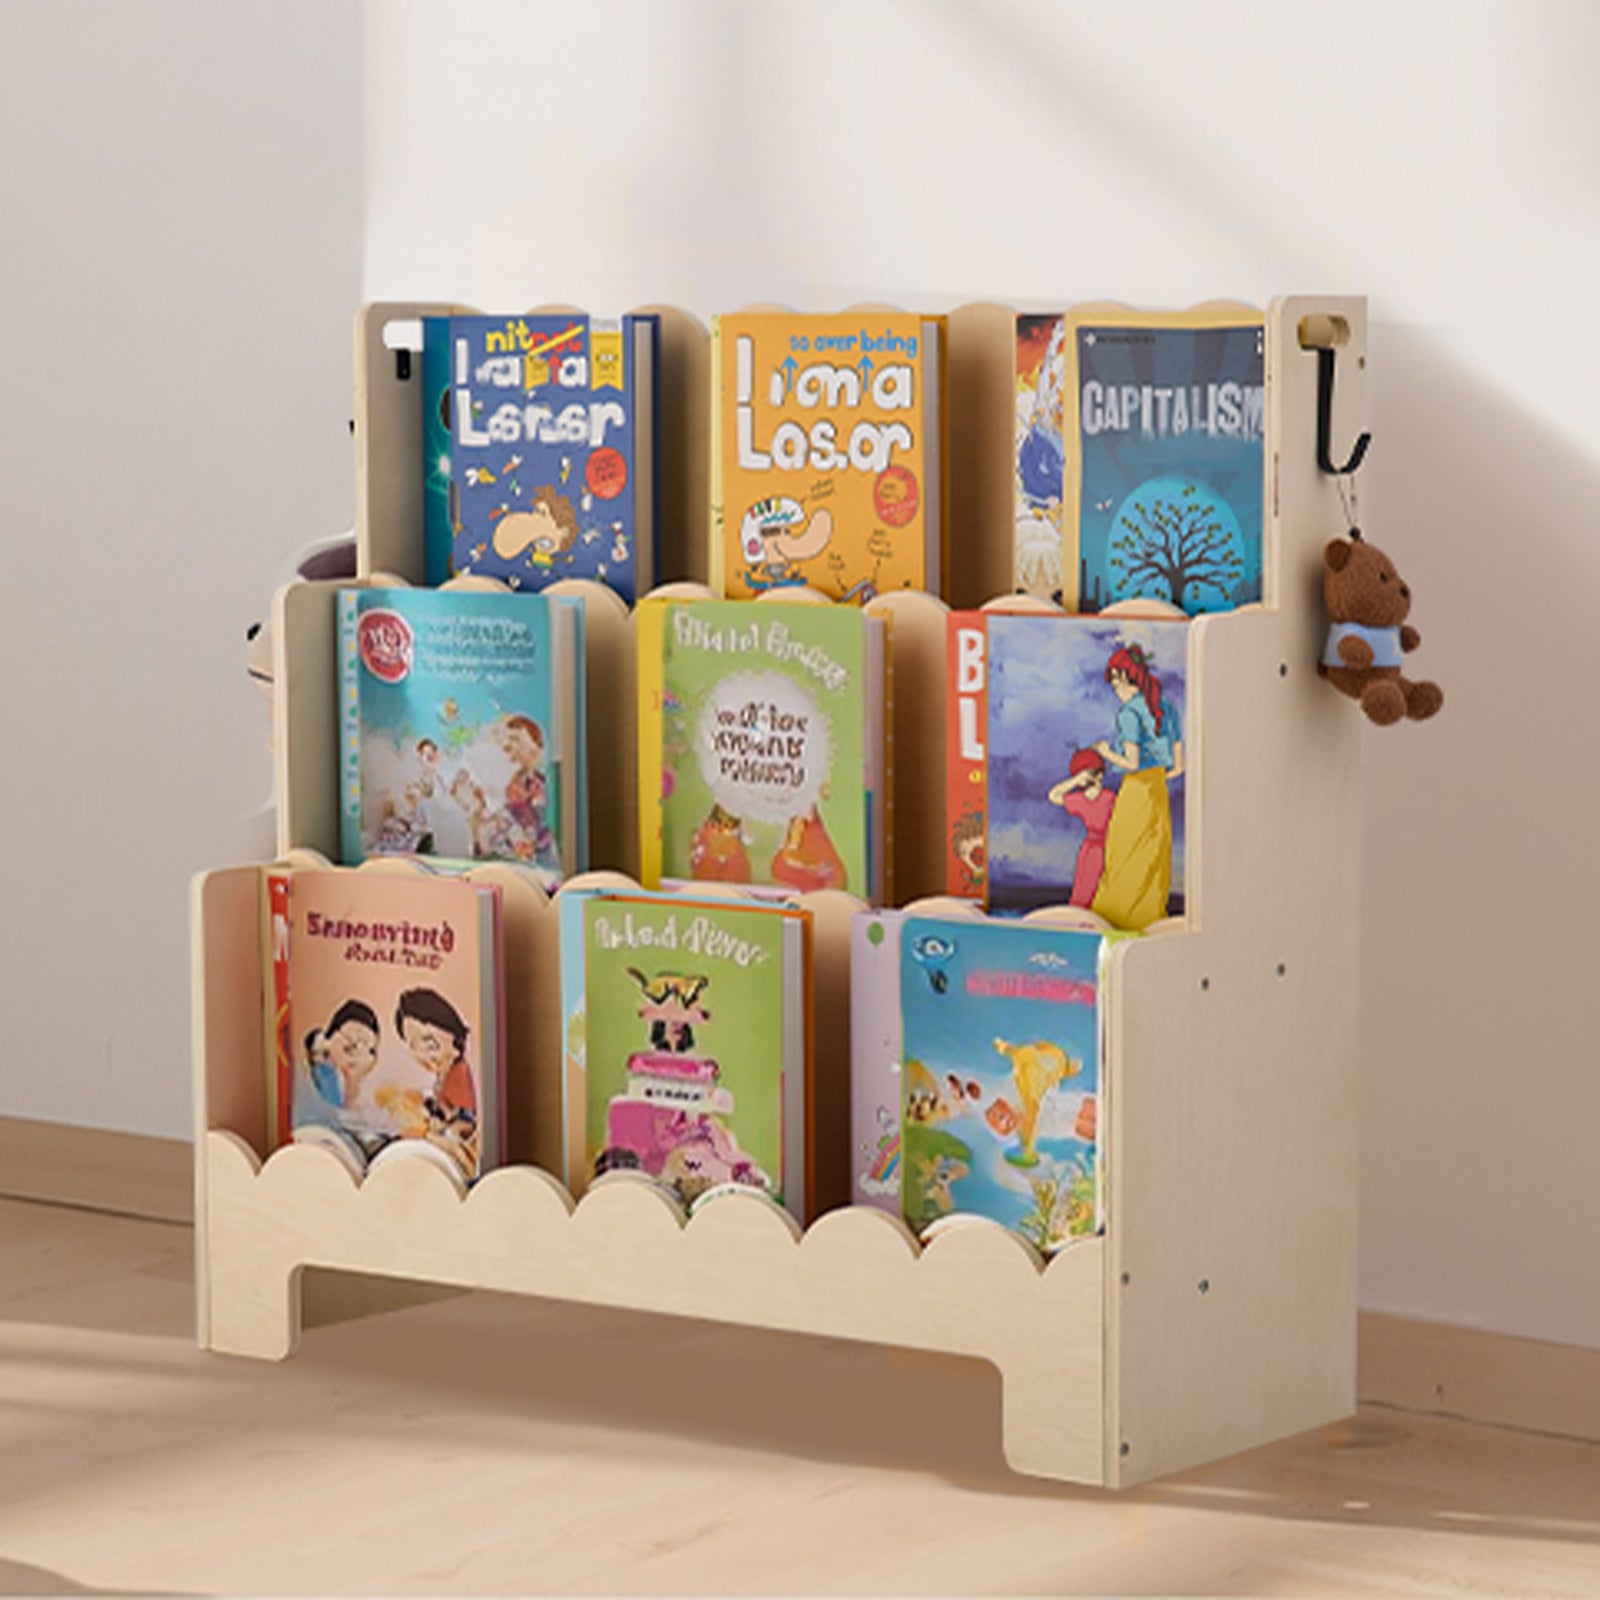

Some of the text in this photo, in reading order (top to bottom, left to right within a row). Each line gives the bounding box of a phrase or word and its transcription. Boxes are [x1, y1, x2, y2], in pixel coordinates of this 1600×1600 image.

[814, 335, 857, 351] over
[859, 329, 918, 358] being
[1081, 379, 1264, 442] CAPITALISM
